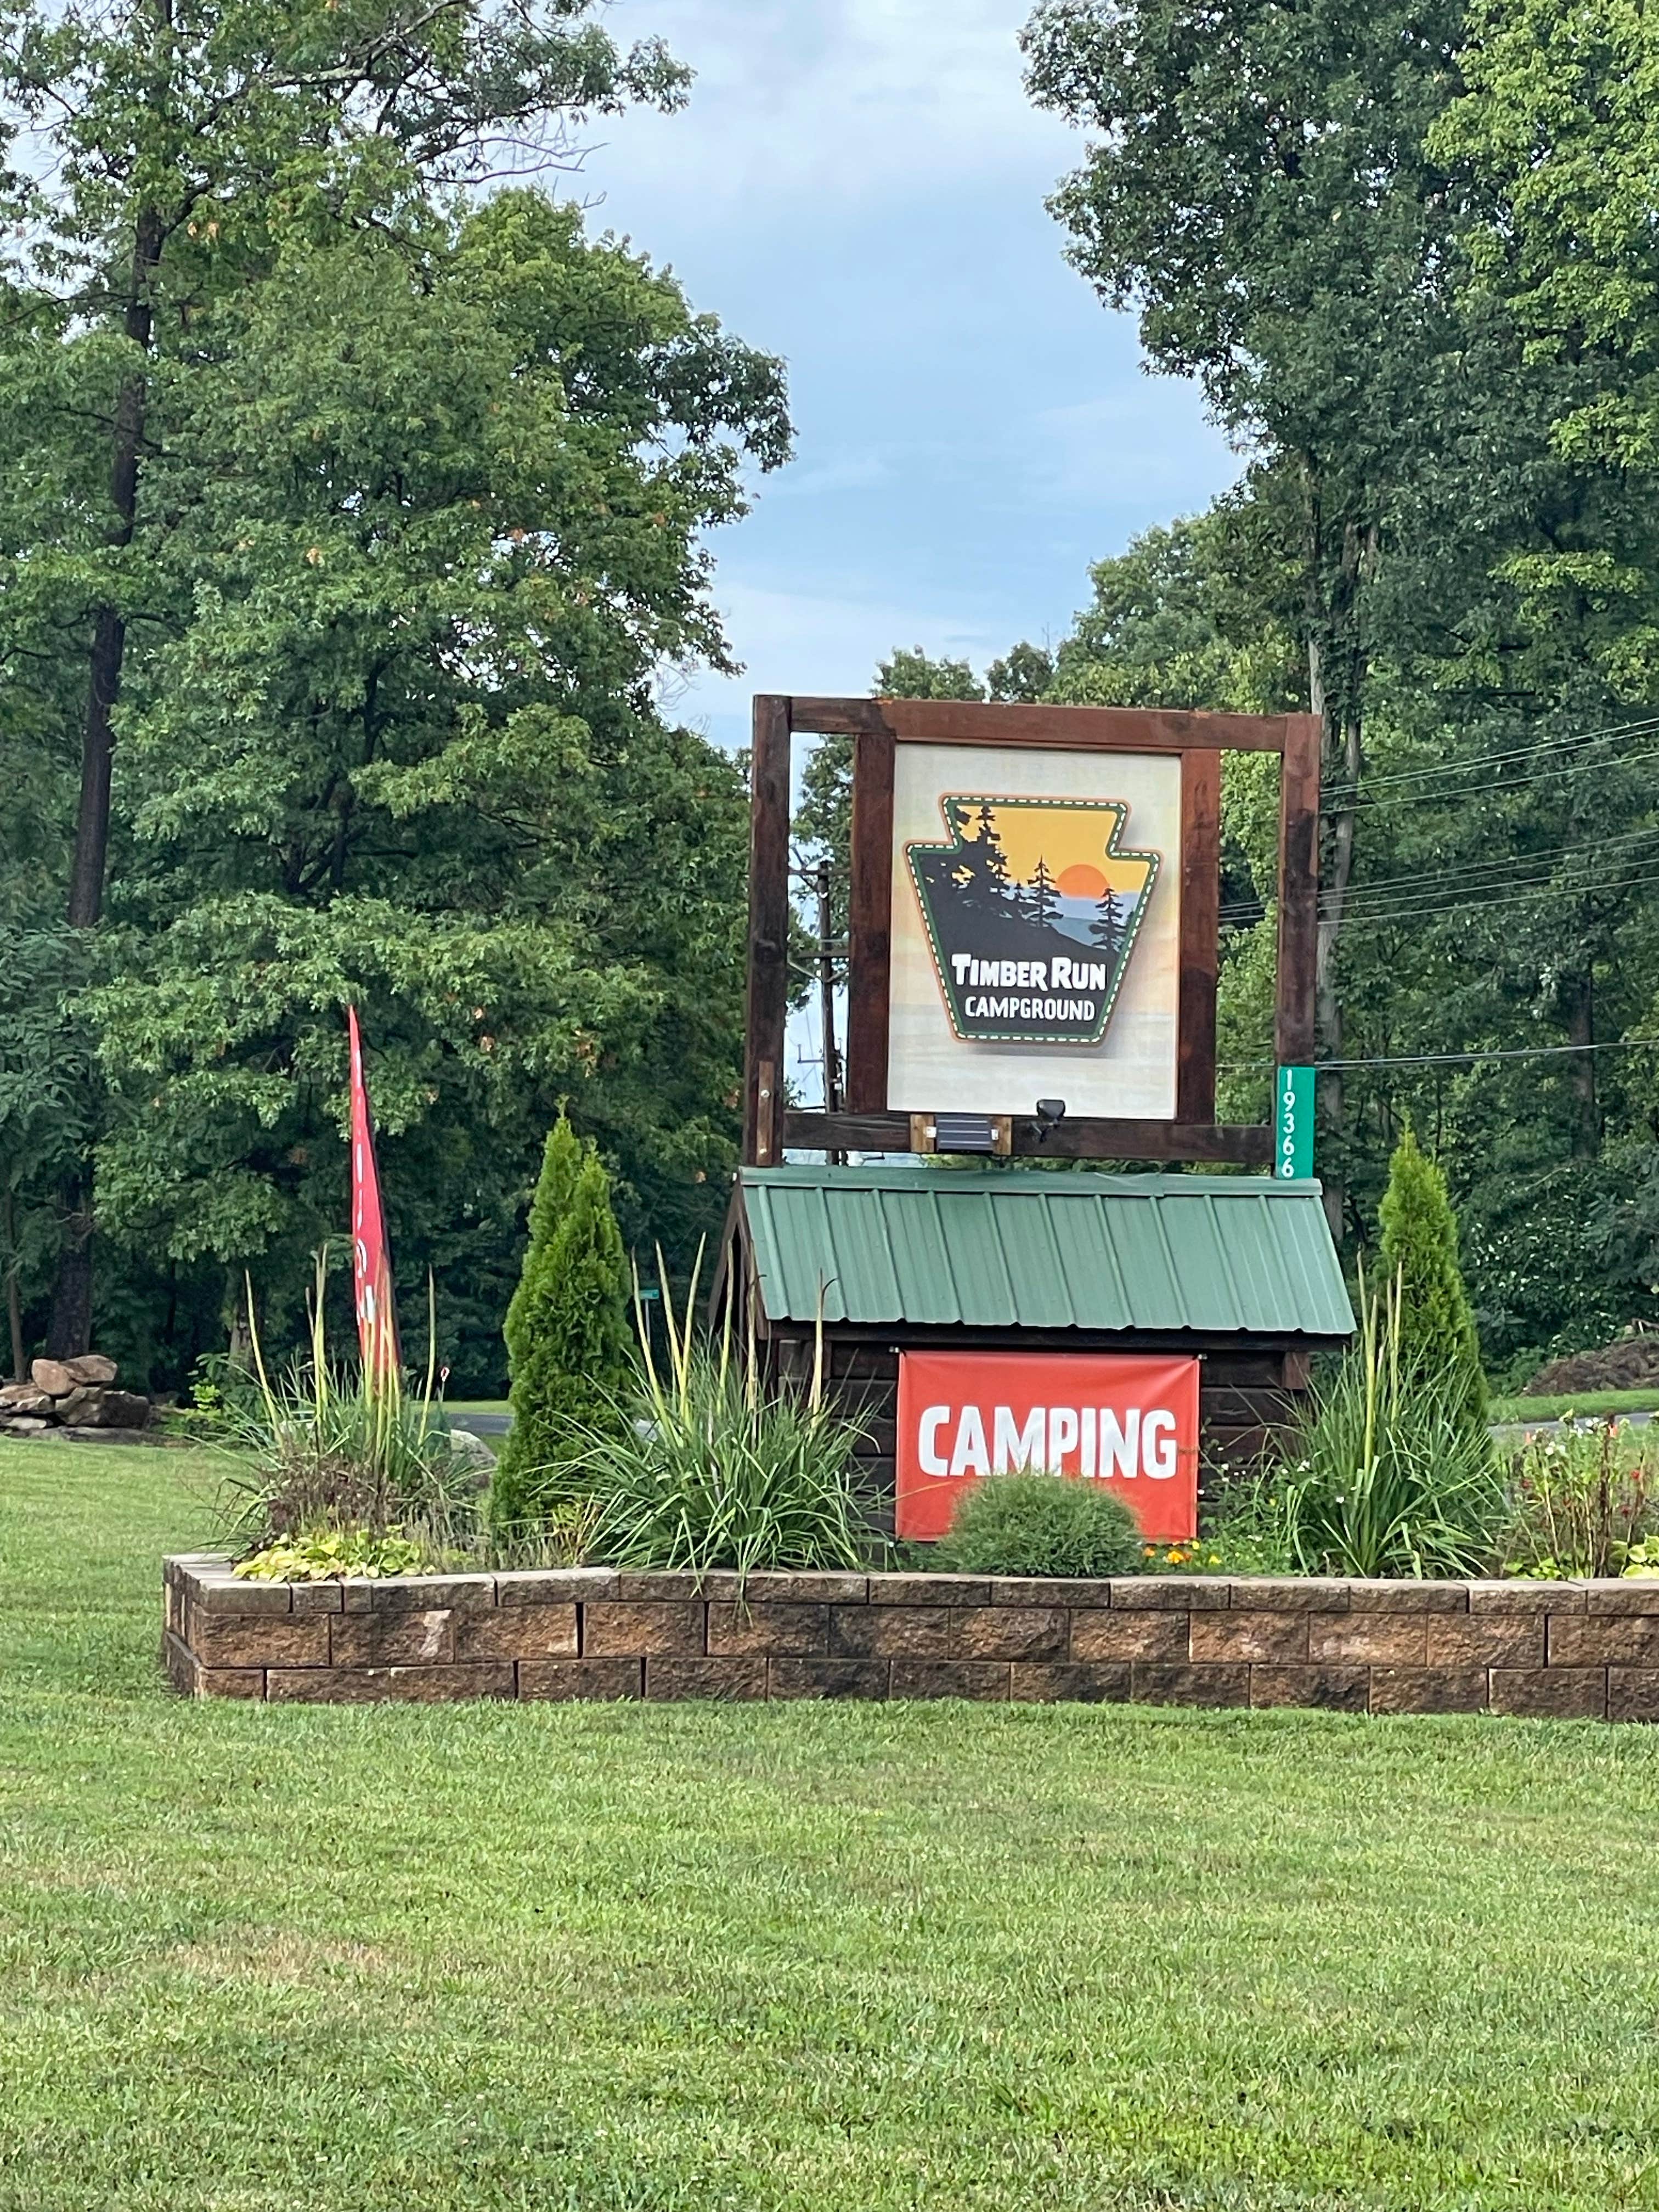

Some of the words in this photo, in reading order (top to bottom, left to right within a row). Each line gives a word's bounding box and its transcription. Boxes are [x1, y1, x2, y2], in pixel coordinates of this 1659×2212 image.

[951, 953, 1048, 991] TIMBER
[1051, 957, 1105, 990] RUN
[965, 996, 1095, 1021] CAMPGROUND
[1282, 1069, 1295, 1178] 19366
[918, 1405, 1178, 1479] CAMPING
